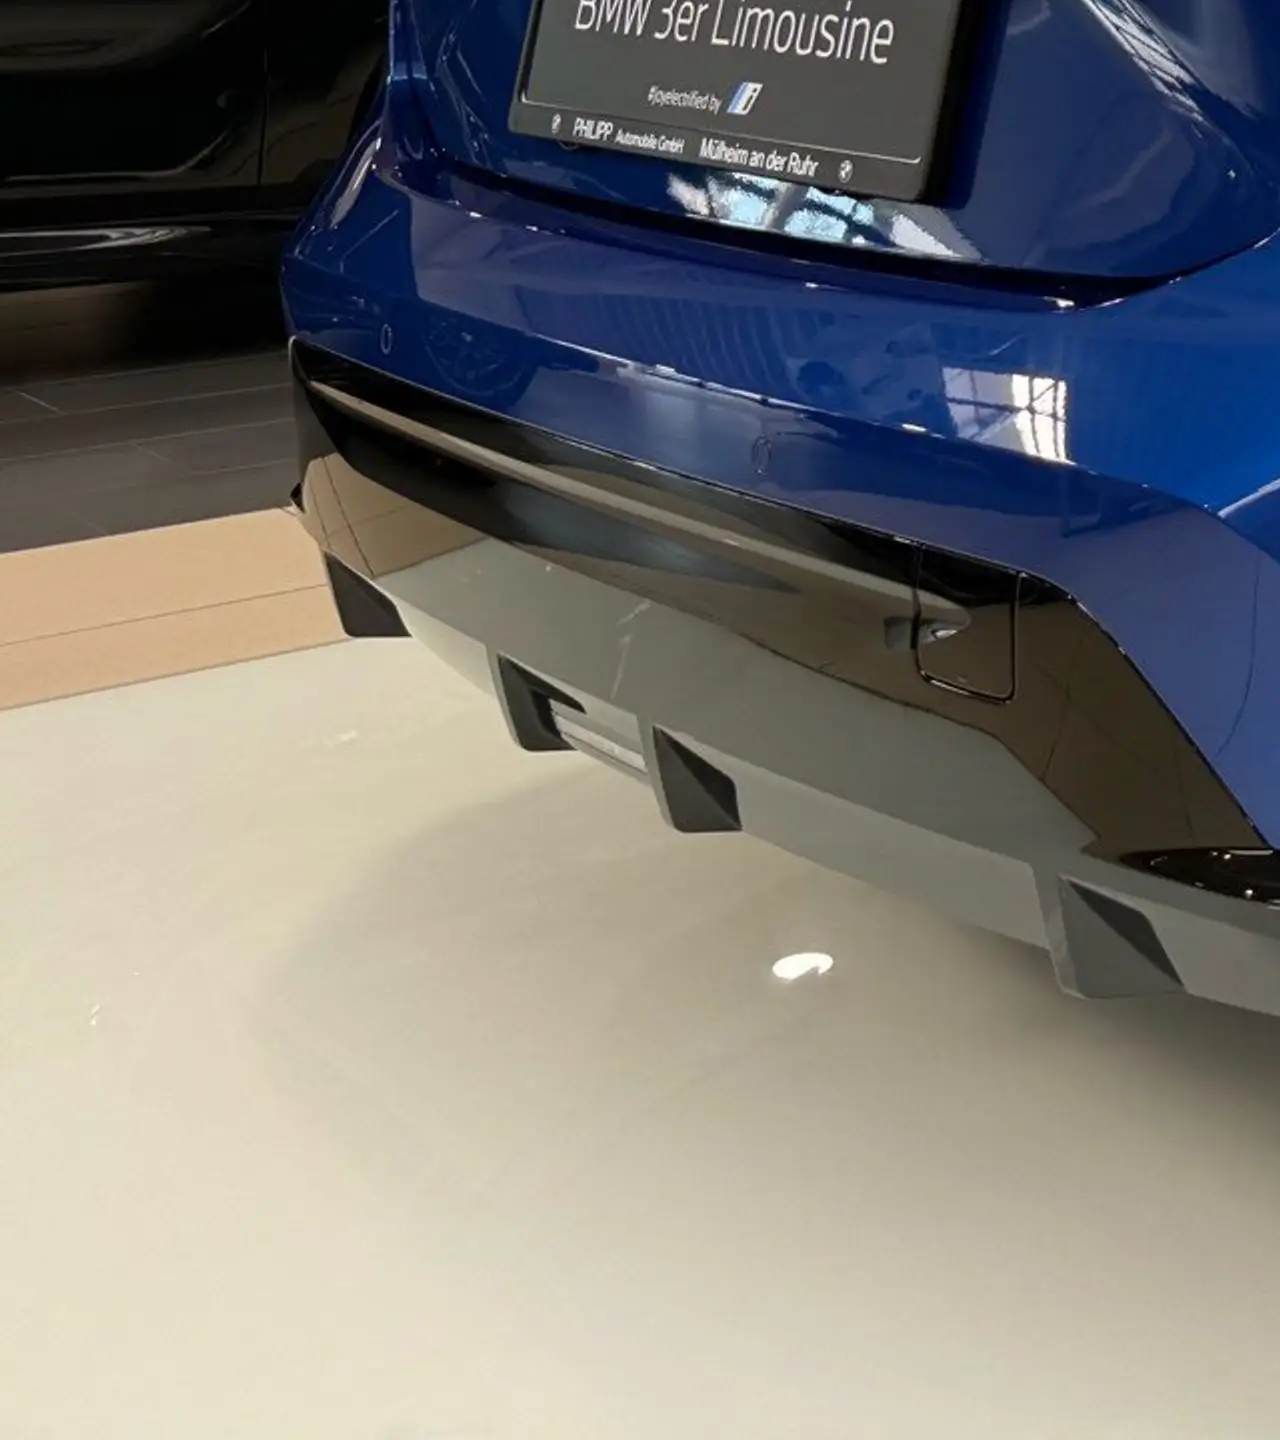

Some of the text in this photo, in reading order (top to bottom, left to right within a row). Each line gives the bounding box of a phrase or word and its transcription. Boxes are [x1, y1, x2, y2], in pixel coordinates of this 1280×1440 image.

[572, 117, 819, 177] PHILIPP Automobile GmbH Mülheim an der Ruhr
